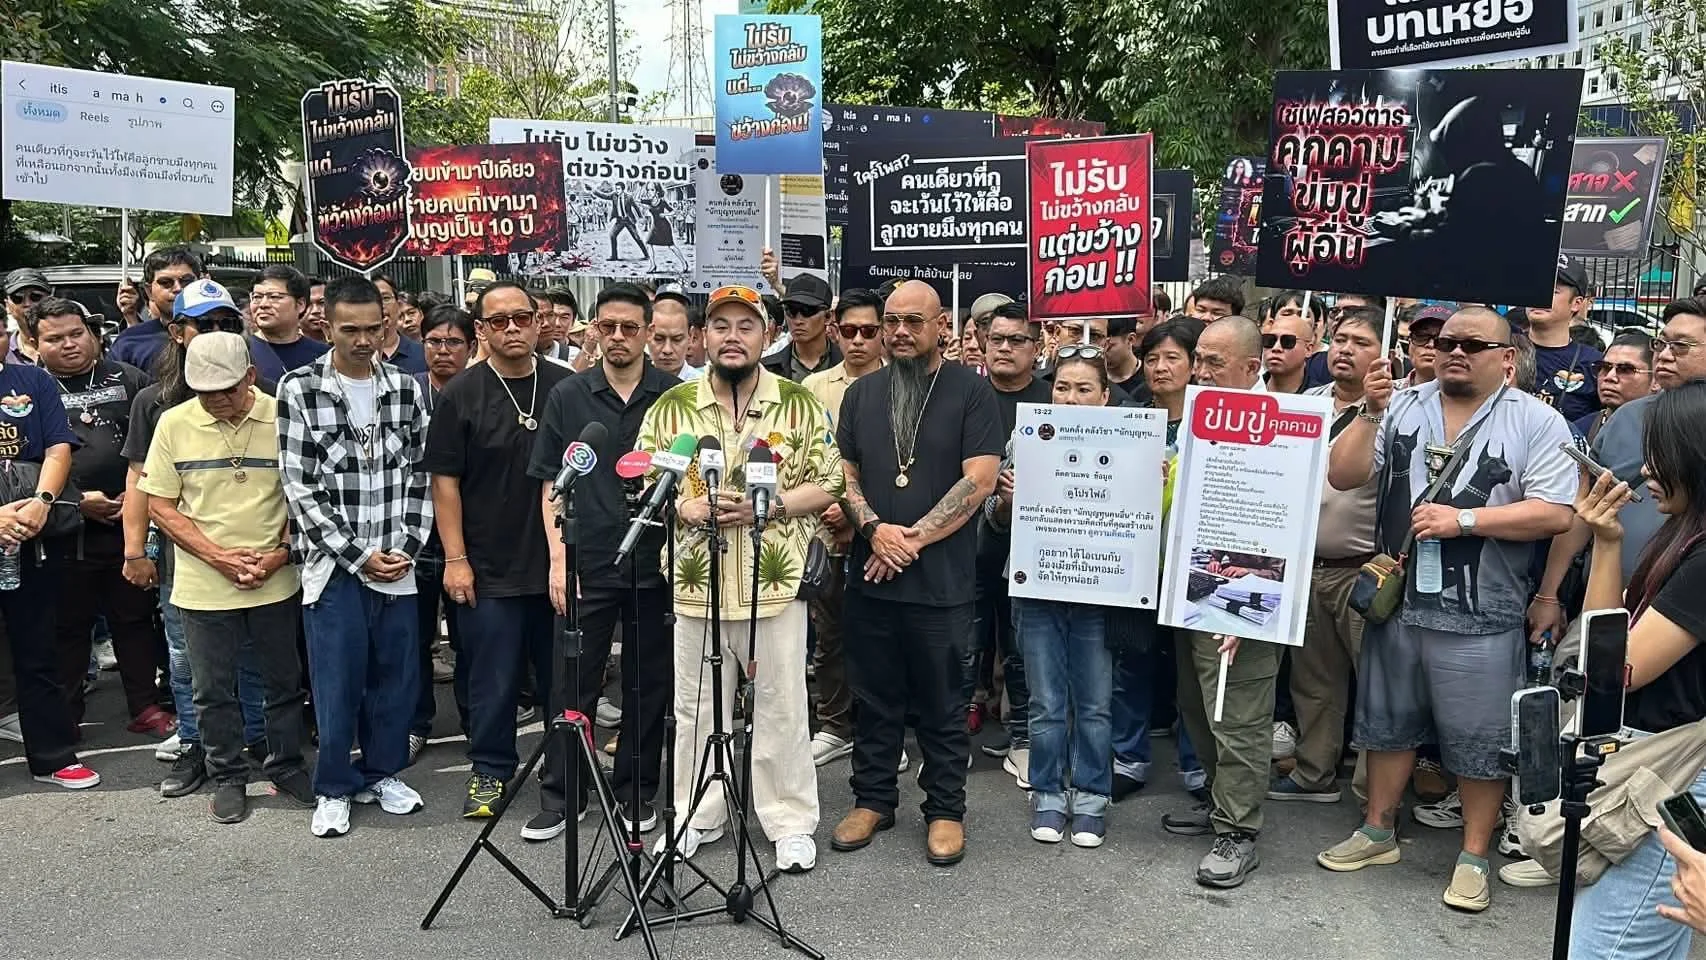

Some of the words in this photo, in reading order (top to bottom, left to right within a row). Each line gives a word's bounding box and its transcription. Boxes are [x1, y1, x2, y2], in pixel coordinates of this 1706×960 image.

[745, 22, 791, 48] ไม่รับ
[730, 44, 807, 69] ไม่ขว้างกลับ
[50, 82, 68, 95] itis
[325, 83, 374, 116] ไม่รับ
[80, 111, 110, 123] Reels
[310, 109, 394, 143] ไม่ขว้างกลับ
[587, 131, 669, 155] ไม่ขว้าง
[1277, 134, 1401, 177] คุกคาม
[411, 158, 535, 181] ยบเข้ามาปีเดียว
[567, 157, 688, 181] ต่ขว้างก่อน
[901, 160, 1001, 191] คนเดียวที่กู
[1050, 157, 1128, 197] ไม่รับ
[408, 186, 538, 214] ร้ายคนที่เขามา
[890, 191, 1012, 214] จะเว้นไว้ให้คือ
[1040, 194, 1140, 221] ไม่ขว้างกลับ
[1296, 172, 1369, 226] ข่มขู่
[1563, 202, 1607, 222] สาก
[410, 213, 484, 247] บุญเป็น
[489, 217, 514, 237] 10
[519, 213, 534, 236] ปี
[880, 217, 1023, 245] ลูกชายมึงทุกคน
[1039, 217, 1142, 260] แต่ขว้าง
[1286, 215, 1363, 273] ผู้อื่น
[1044, 254, 1107, 295] ก่อน
[1205, 398, 1267, 443] ข่มขู่
[1269, 419, 1317, 434] คุกคาม
